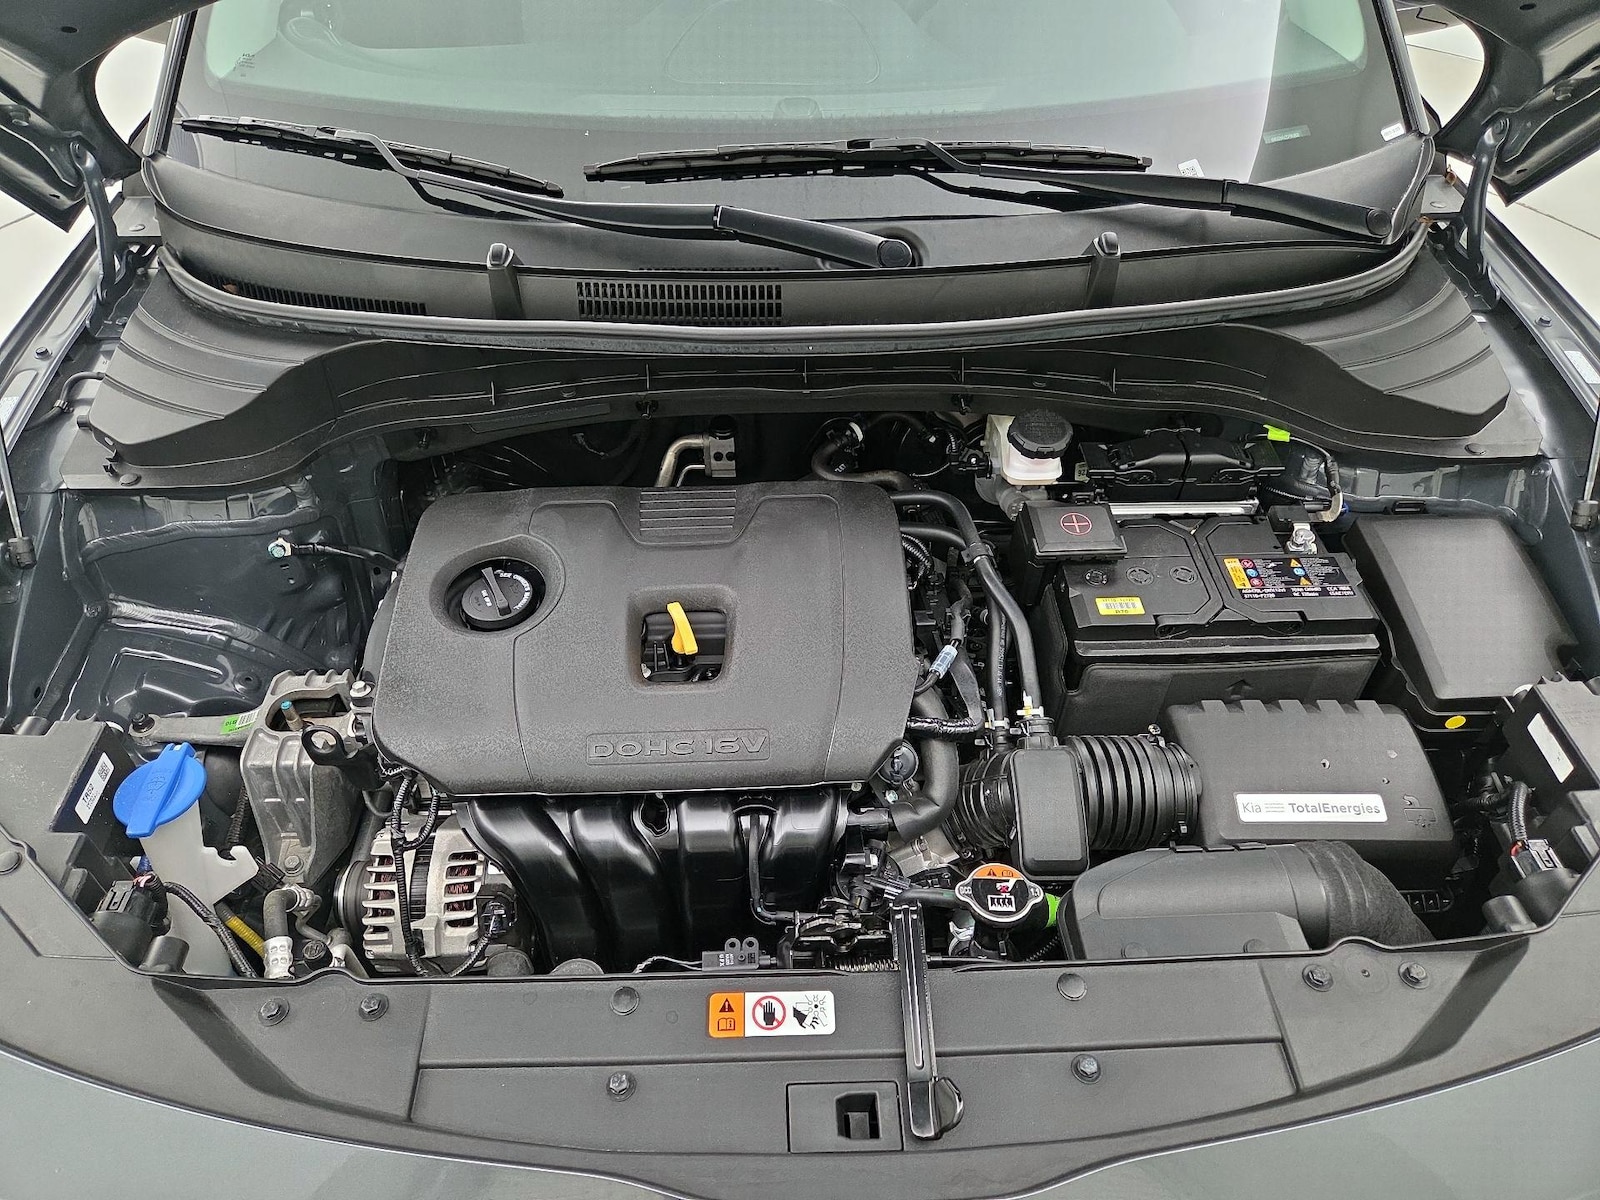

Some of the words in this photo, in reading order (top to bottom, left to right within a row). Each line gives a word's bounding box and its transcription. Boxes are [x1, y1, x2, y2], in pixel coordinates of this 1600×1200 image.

[588, 739, 695, 759] DOHC
[704, 735, 768, 755] 16V
[1242, 802, 1262, 814] Kia
[1288, 802, 1381, 816] TotalEnergies
